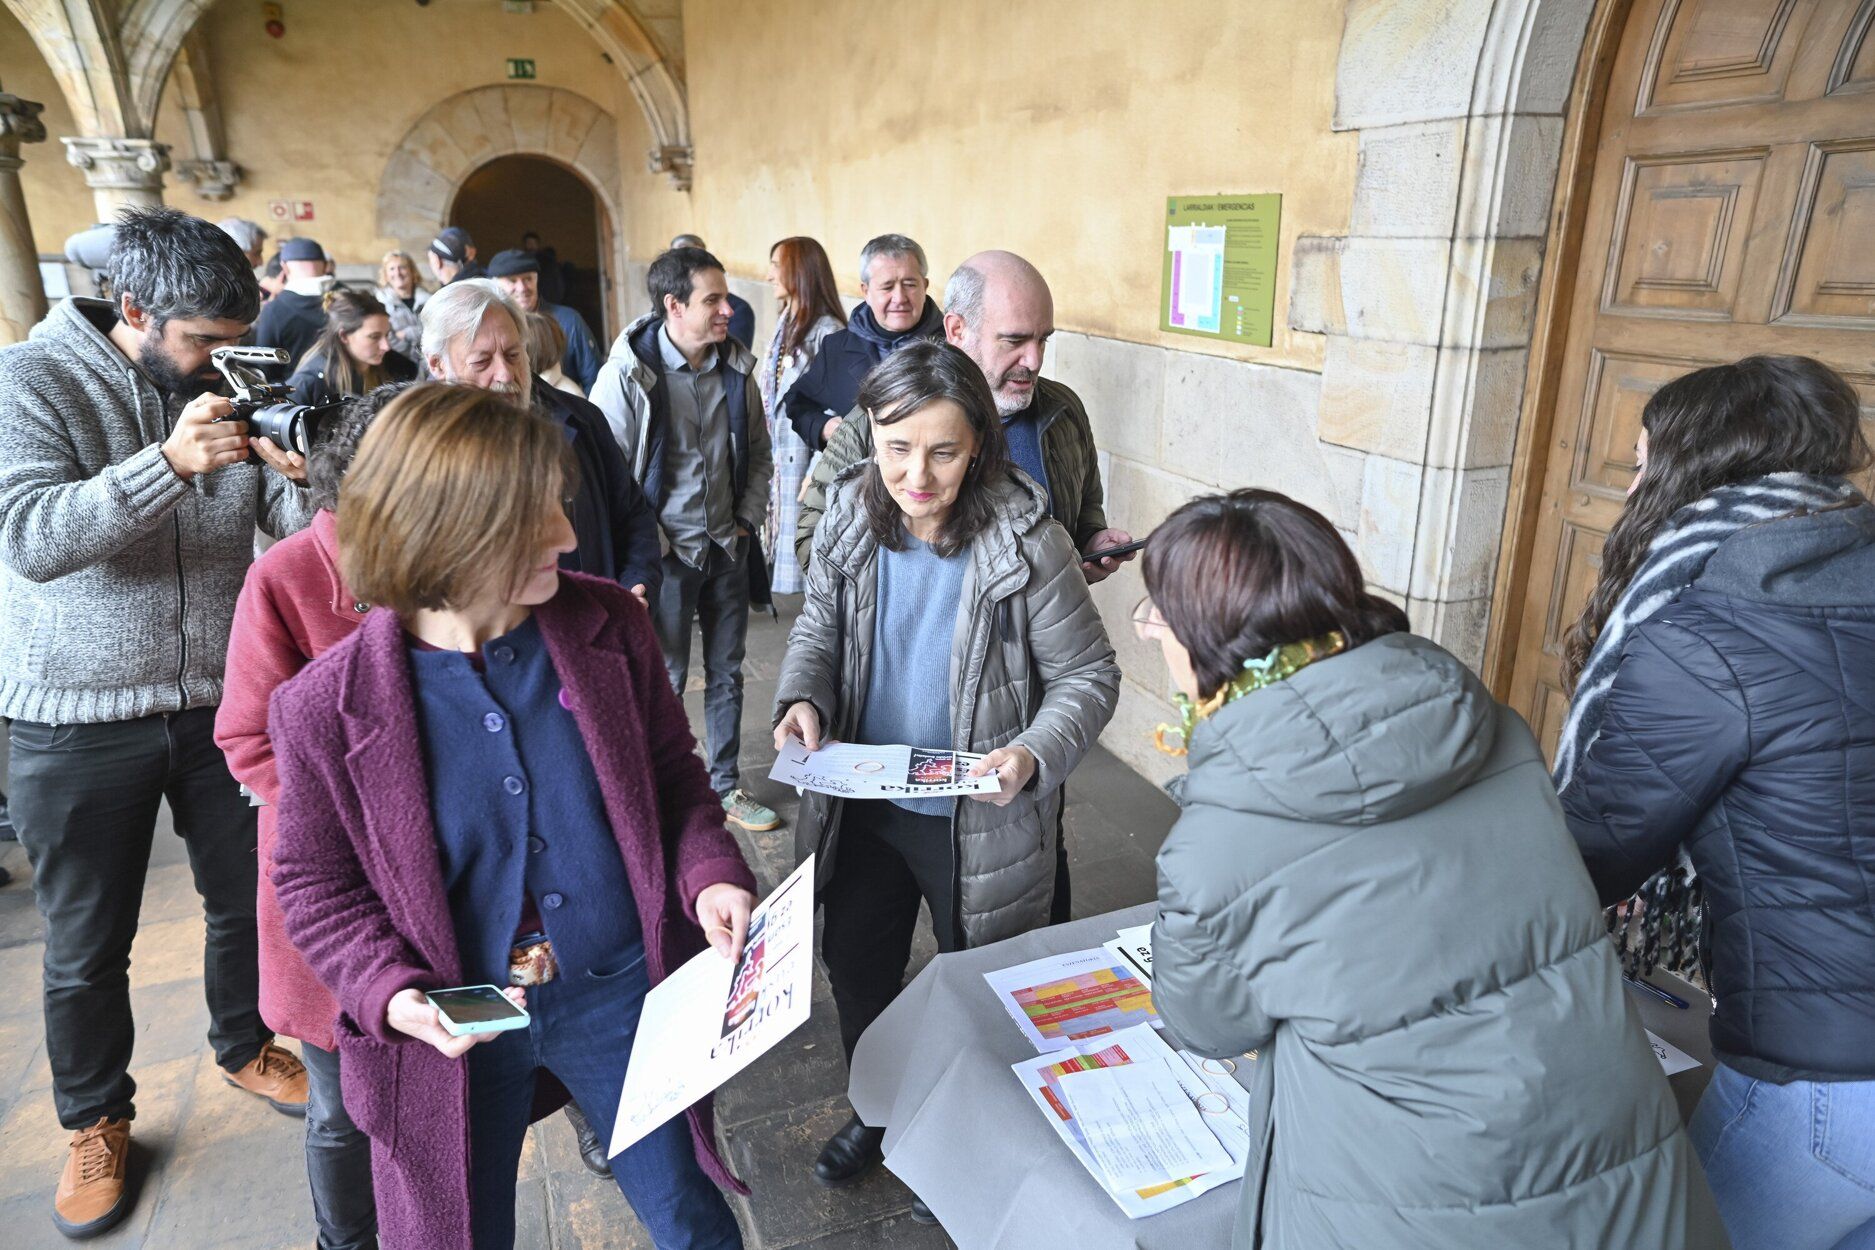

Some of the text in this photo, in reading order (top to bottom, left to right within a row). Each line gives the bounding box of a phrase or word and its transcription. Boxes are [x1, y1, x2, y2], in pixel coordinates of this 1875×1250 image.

[881, 784, 979, 793] korrika
[1136, 946, 1150, 957] ez
[710, 983, 793, 1059] korrika
